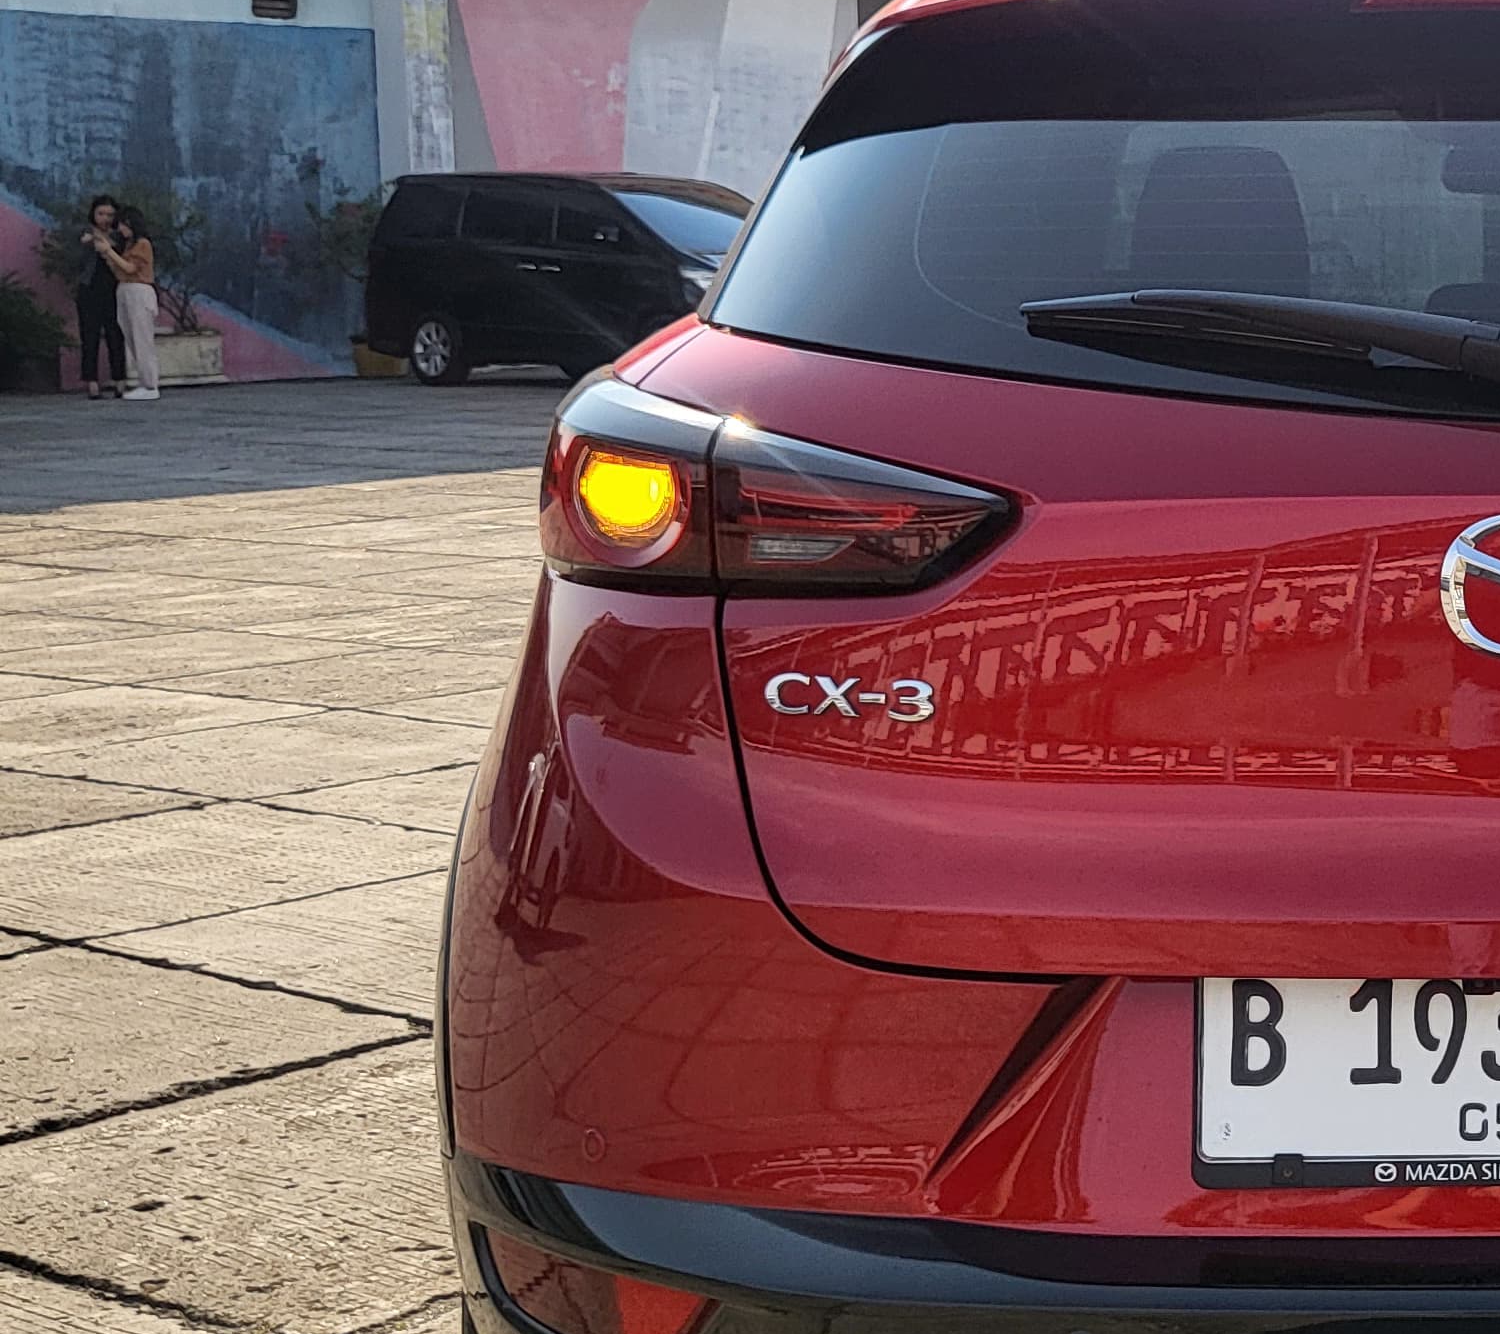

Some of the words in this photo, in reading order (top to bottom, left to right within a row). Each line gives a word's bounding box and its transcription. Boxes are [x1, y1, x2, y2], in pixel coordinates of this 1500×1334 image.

[764, 672, 935, 722] CX-3
[1231, 978, 1287, 1086] B
[1405, 1163, 1478, 1182] MAZDA
